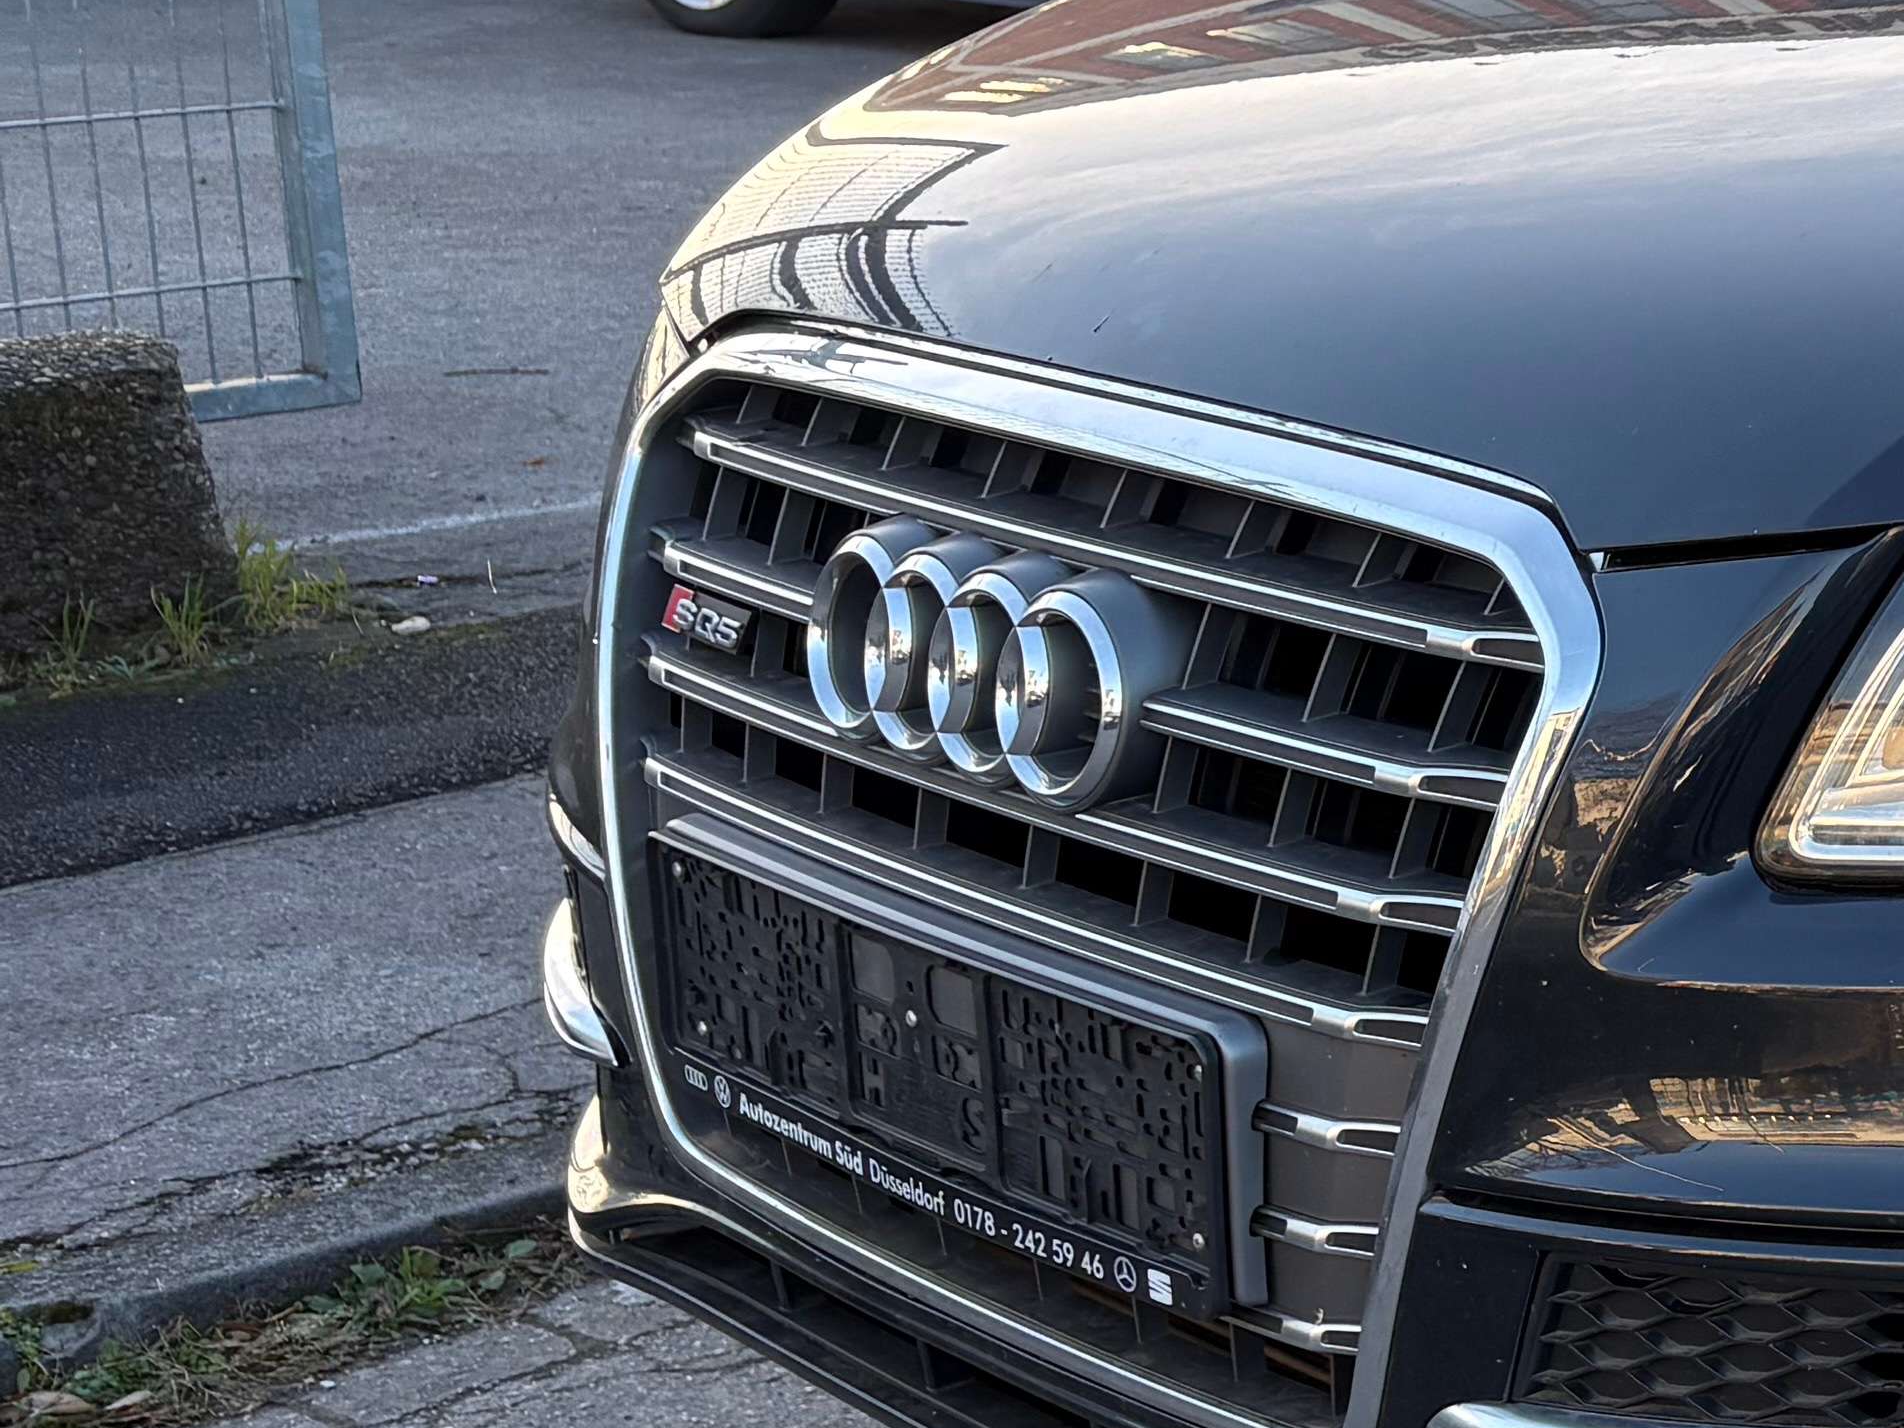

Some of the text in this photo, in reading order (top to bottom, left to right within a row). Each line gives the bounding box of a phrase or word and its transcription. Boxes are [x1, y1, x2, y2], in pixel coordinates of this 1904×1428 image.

[673, 599, 738, 648] SQ5
[739, 1093, 832, 1160] Autozentrum
[835, 1140, 863, 1176] Süd
[869, 1158, 946, 1216] Düsseldorf
[954, 1198, 995, 1237] 0178
[1013, 1223, 1047, 1259] 242
[1053, 1239, 1074, 1267] 59
[1081, 1251, 1105, 1280] 46
